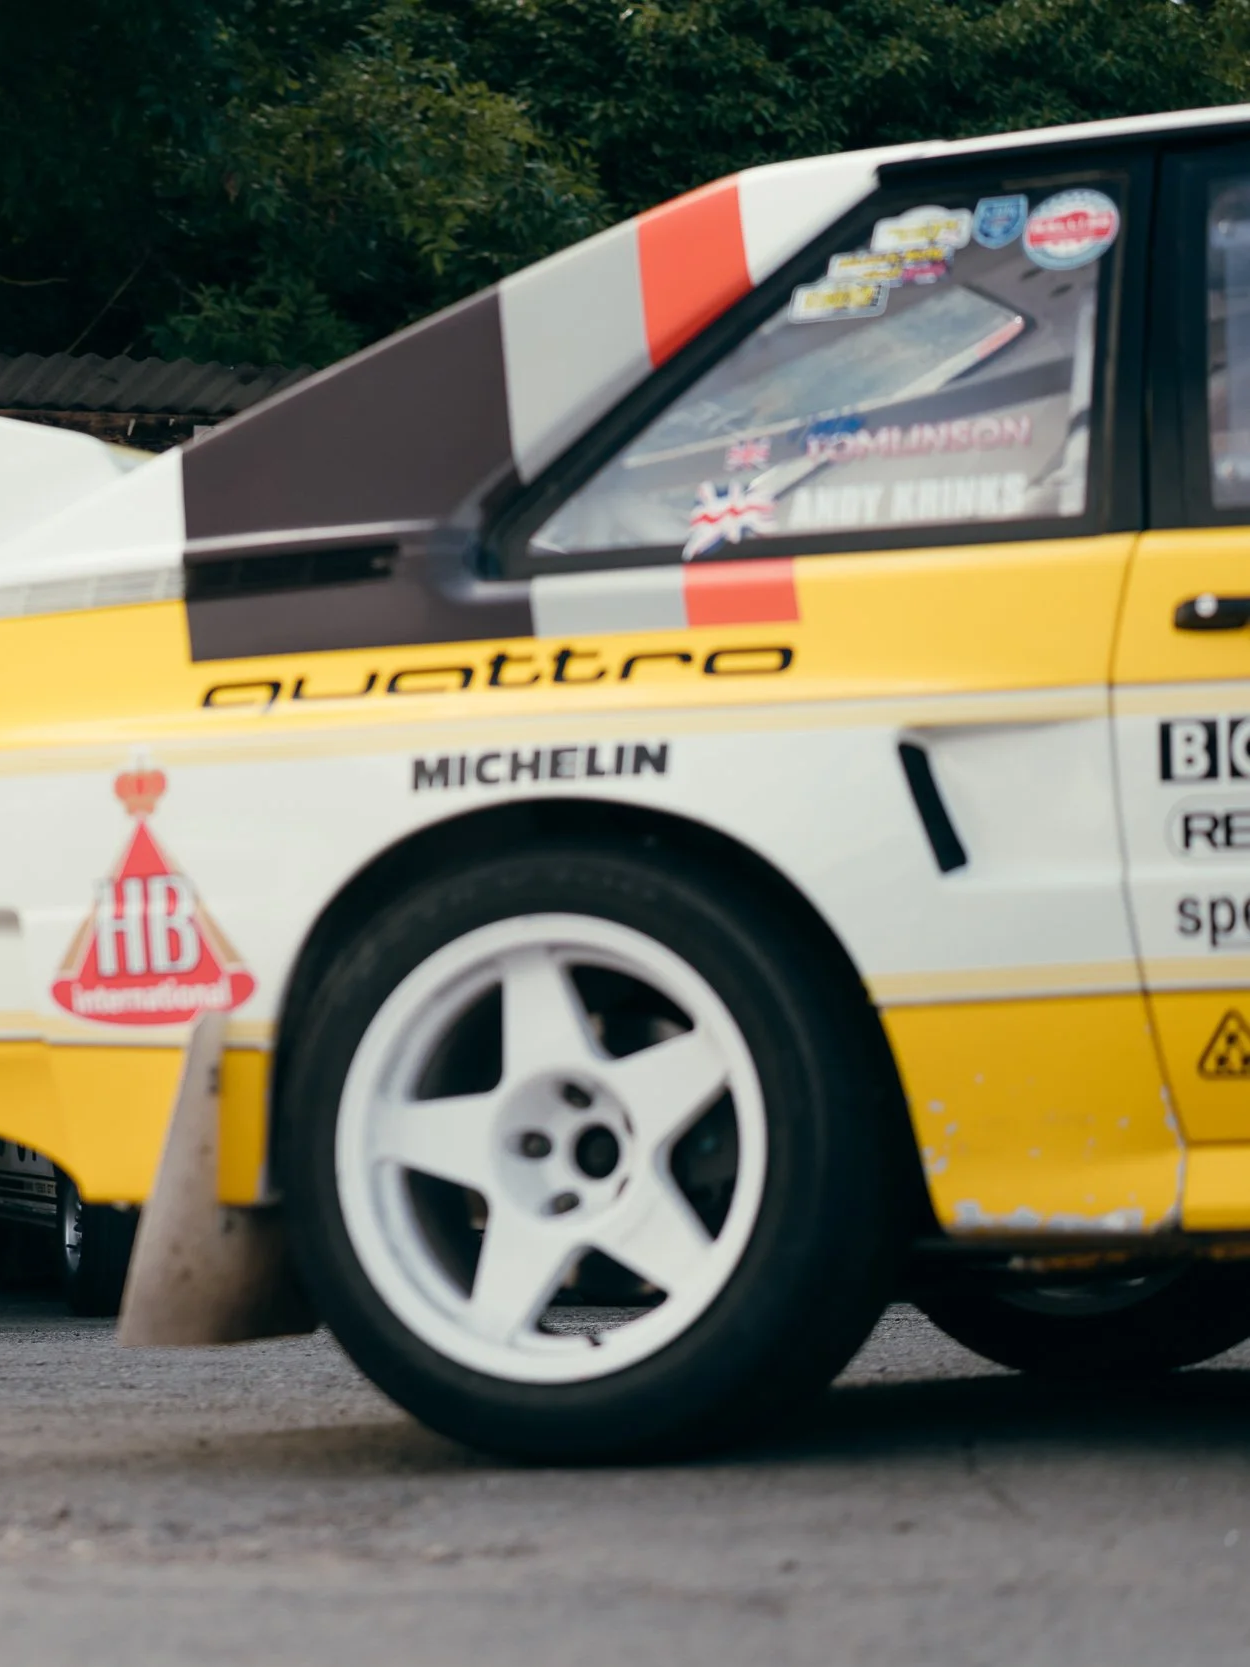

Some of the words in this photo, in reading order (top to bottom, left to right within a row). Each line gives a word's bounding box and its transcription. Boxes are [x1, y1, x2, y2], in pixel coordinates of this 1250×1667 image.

[788, 484, 882, 530] ANDY
[890, 474, 1030, 522] KRINKS
[201, 645, 793, 714] quattro
[412, 742, 668, 792] MICHELIN
[94, 874, 201, 977] HB
[1177, 898, 1250, 946] sp
